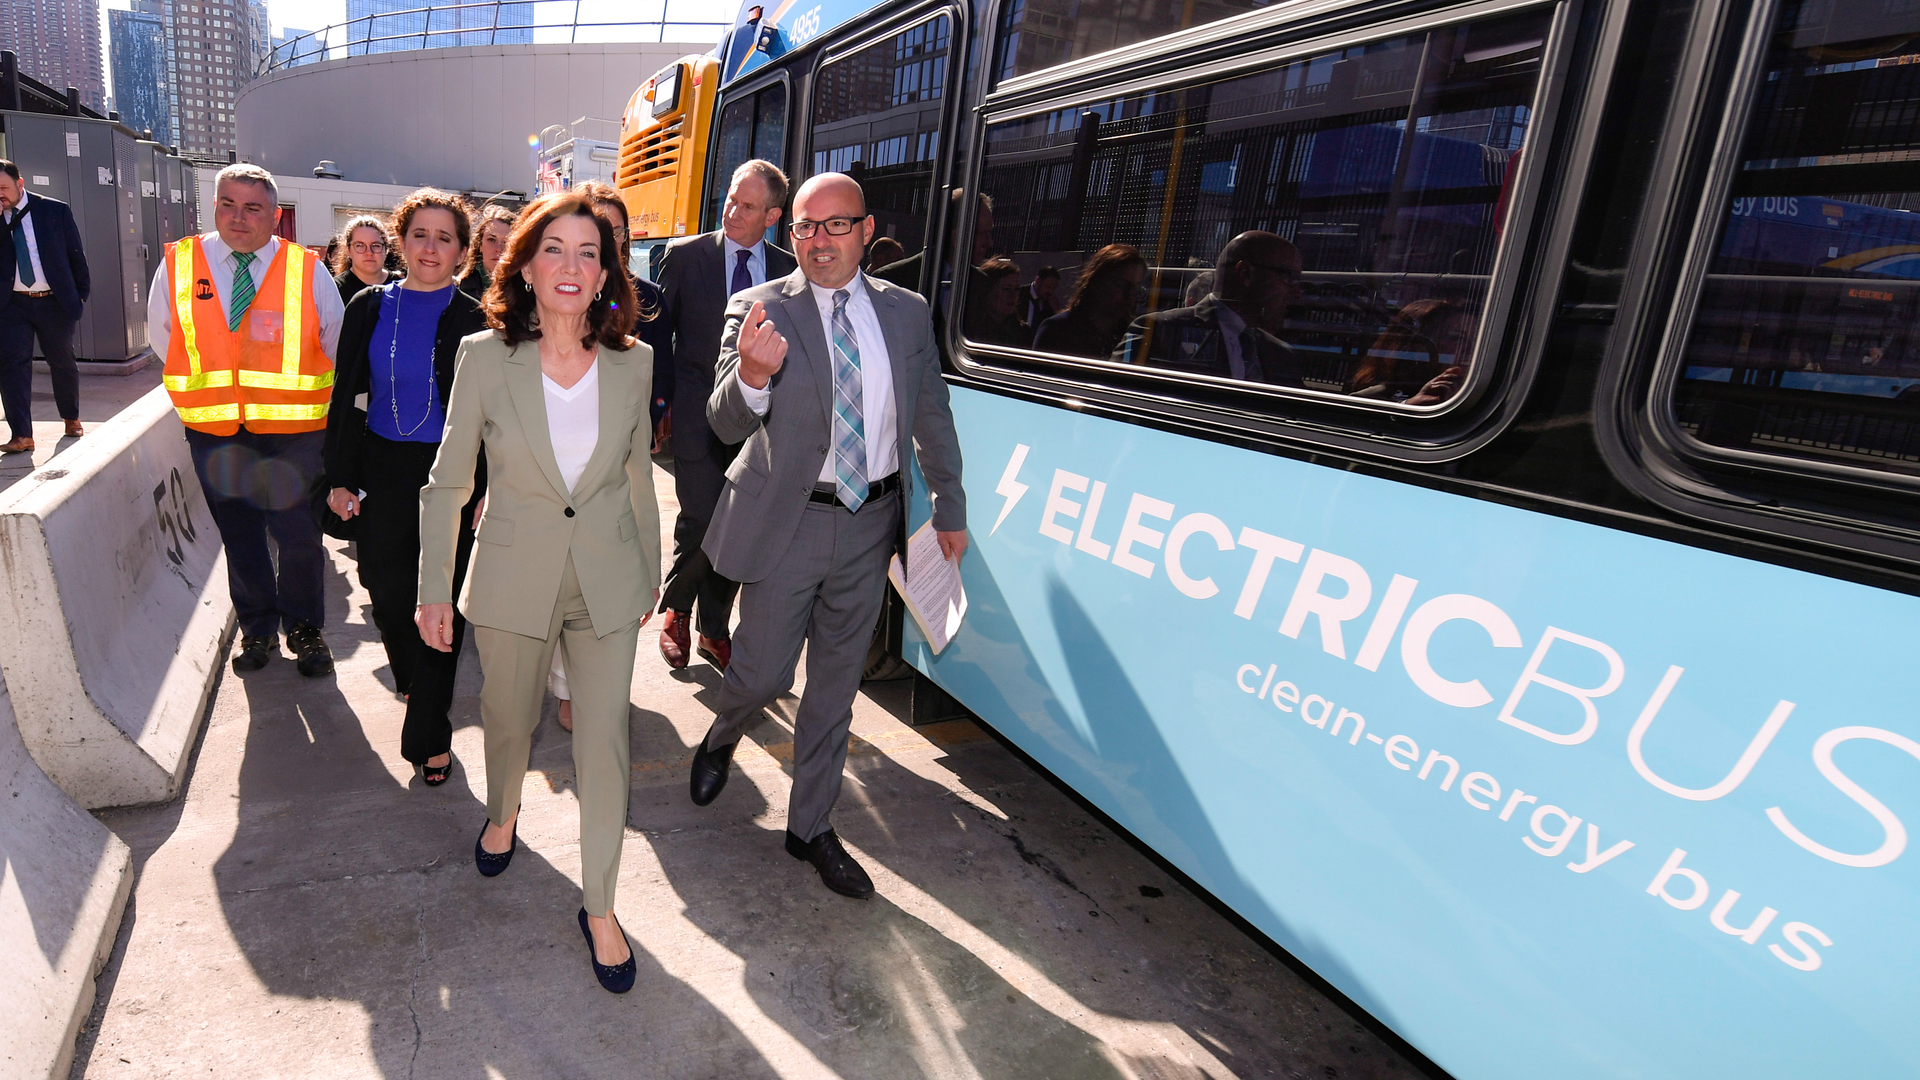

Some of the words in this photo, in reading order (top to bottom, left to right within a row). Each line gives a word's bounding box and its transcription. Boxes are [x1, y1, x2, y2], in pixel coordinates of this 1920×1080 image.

[789, 4, 822, 46] 4955
[1763, 197, 1799, 217] bus
[152, 466, 196, 566] 50
[1235, 655, 1636, 875] clean-energy
[1646, 847, 1835, 972] bus
